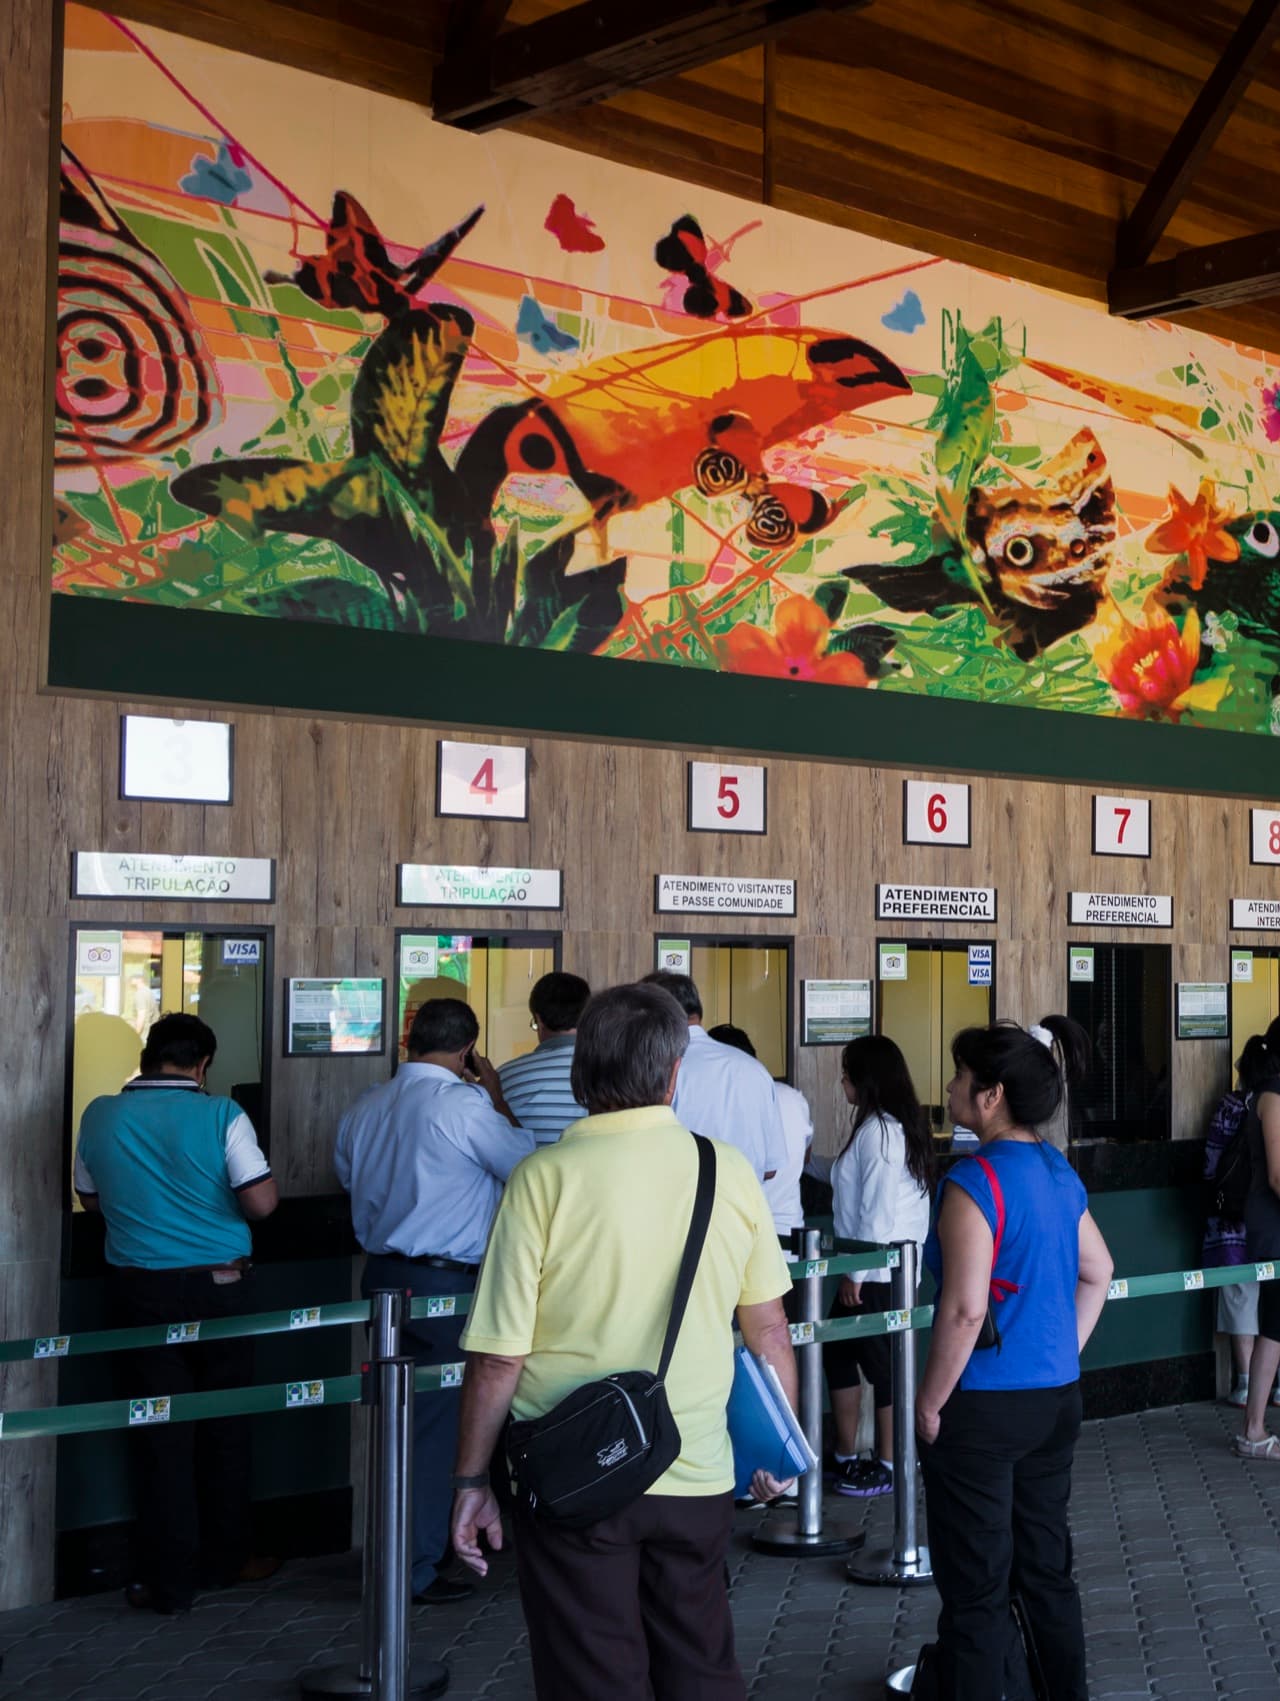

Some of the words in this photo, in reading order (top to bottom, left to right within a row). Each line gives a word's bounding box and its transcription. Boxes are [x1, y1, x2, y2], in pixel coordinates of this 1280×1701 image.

[470, 758, 497, 804] 4
[717, 776, 740, 819] 5
[927, 793, 948, 834] 6
[1113, 808, 1131, 844] 7
[124, 876, 230, 894] TRIPULAÇÃO
[663, 880, 735, 893] ATENDIMENTO
[737, 883, 792, 895] VISITANTES
[440, 885, 527, 903] TRIPULAÇÃO
[885, 888, 988, 903] ATENDIMENTO
[1088, 895, 1157, 908] ATENDIMENTO
[672, 895, 679, 905] E
[682, 896, 715, 907] PASSE
[717, 897, 783, 909] COMUNIDADE
[882, 902, 991, 916] PREFERENCIAL
[1086, 910, 1159, 923] PREFERENCIAL
[227, 942, 258, 955] VISA
[971, 948, 990, 958] VISA
[971, 968, 990, 978] VISA
